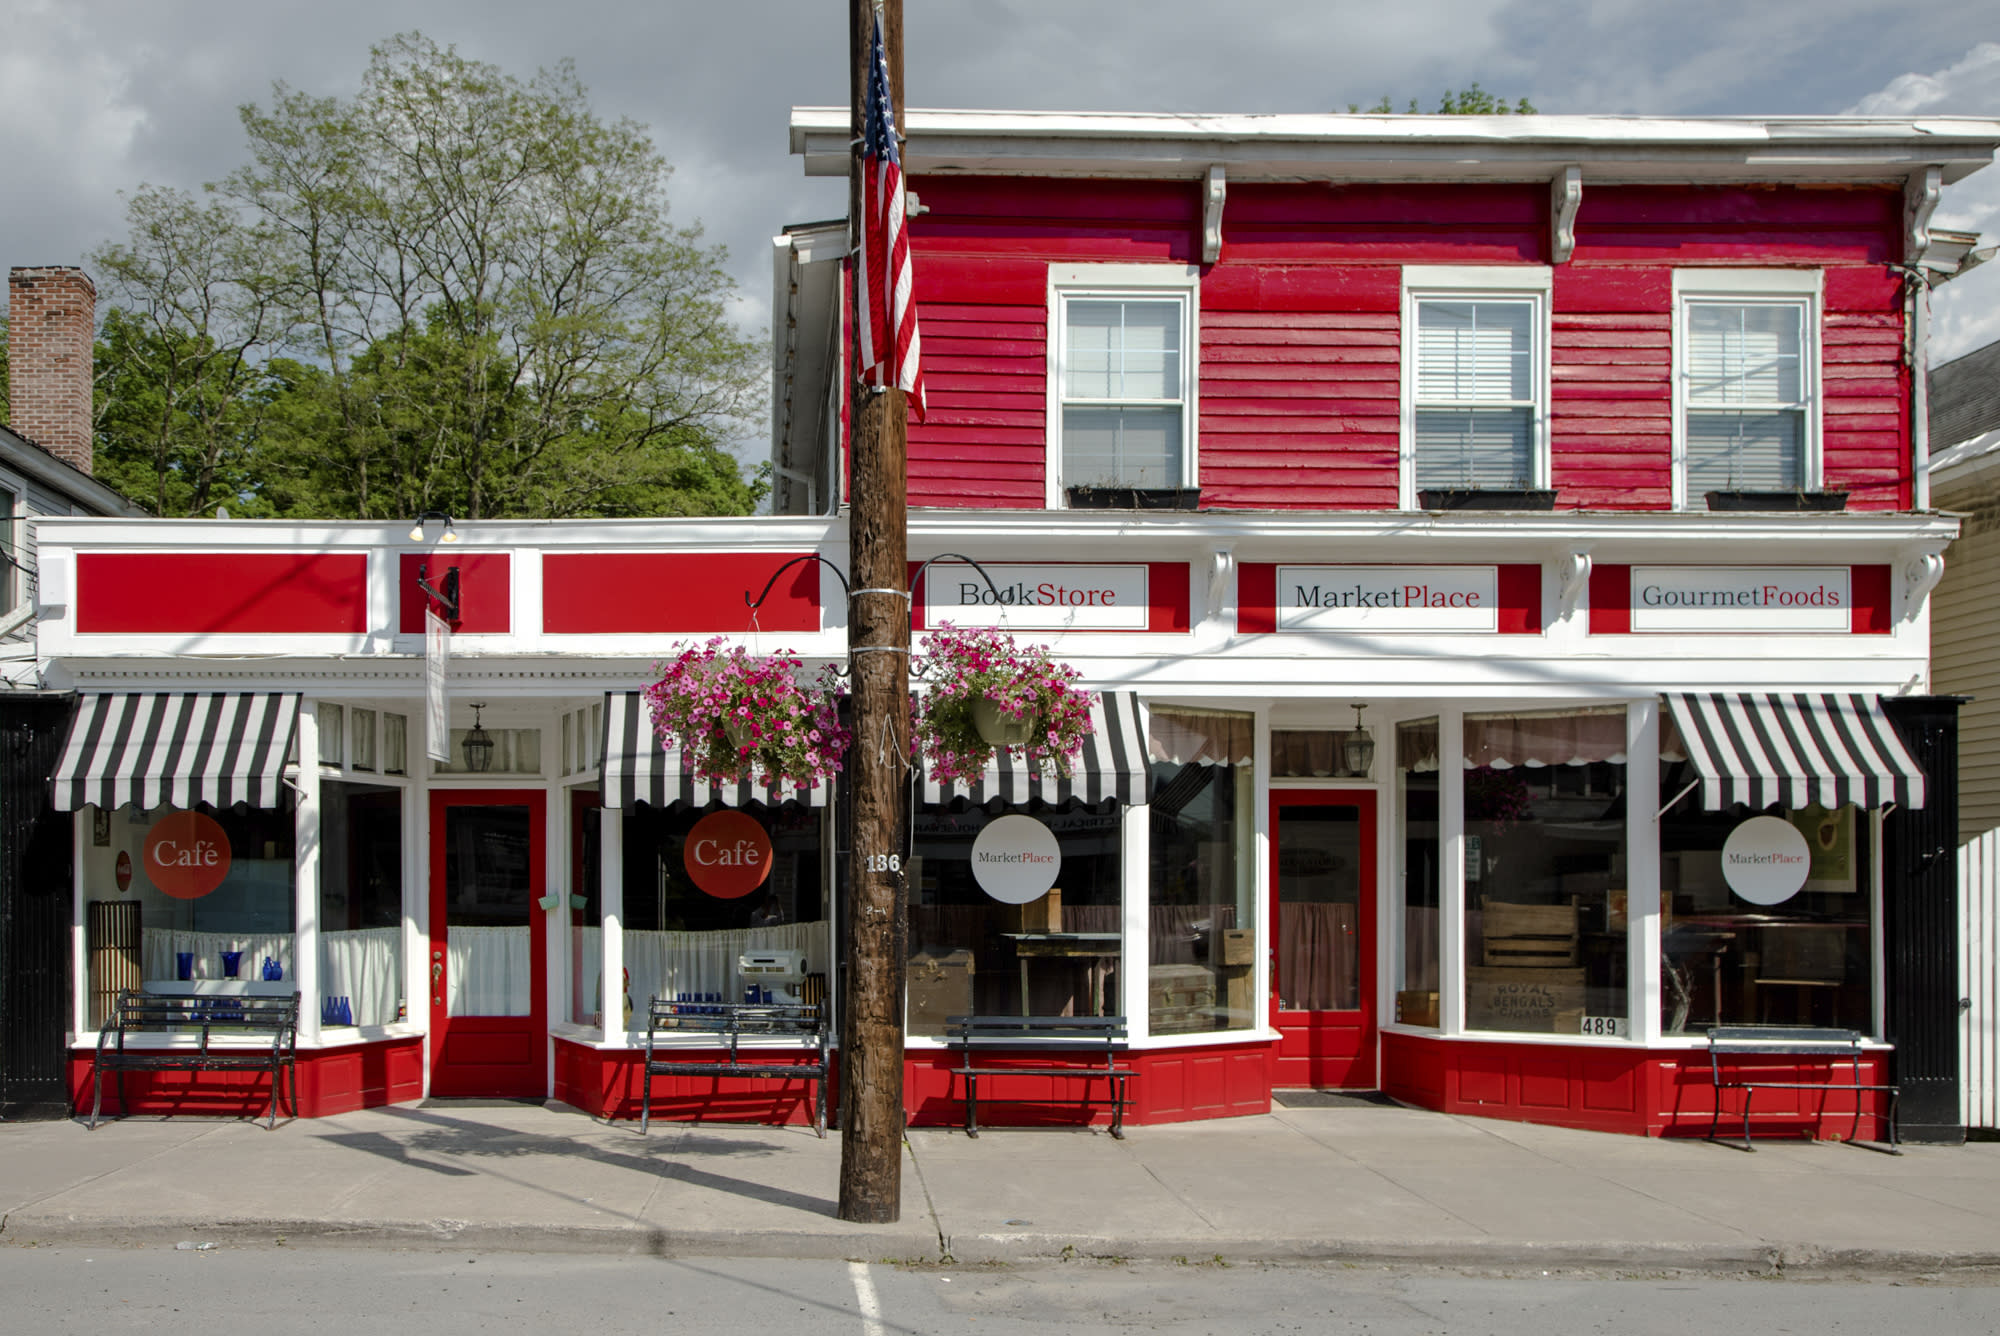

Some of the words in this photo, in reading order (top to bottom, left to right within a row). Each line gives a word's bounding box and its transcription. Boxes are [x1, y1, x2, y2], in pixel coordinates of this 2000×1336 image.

[958, 582, 1116, 606] BookStore
[1294, 584, 1481, 608] MarketPlace
[1642, 585, 1840, 607] GourmetFoods
[153, 839, 219, 867] Café
[694, 839, 760, 866] Café
[978, 851, 1054, 863] MarketPlace
[1728, 852, 1804, 864] MarketPlace
[866, 854, 900, 872] 136
[1496, 983, 1551, 996] ROYAL
[1493, 996, 1555, 1008] BENGALS
[1582, 1018, 1616, 1035] 489
